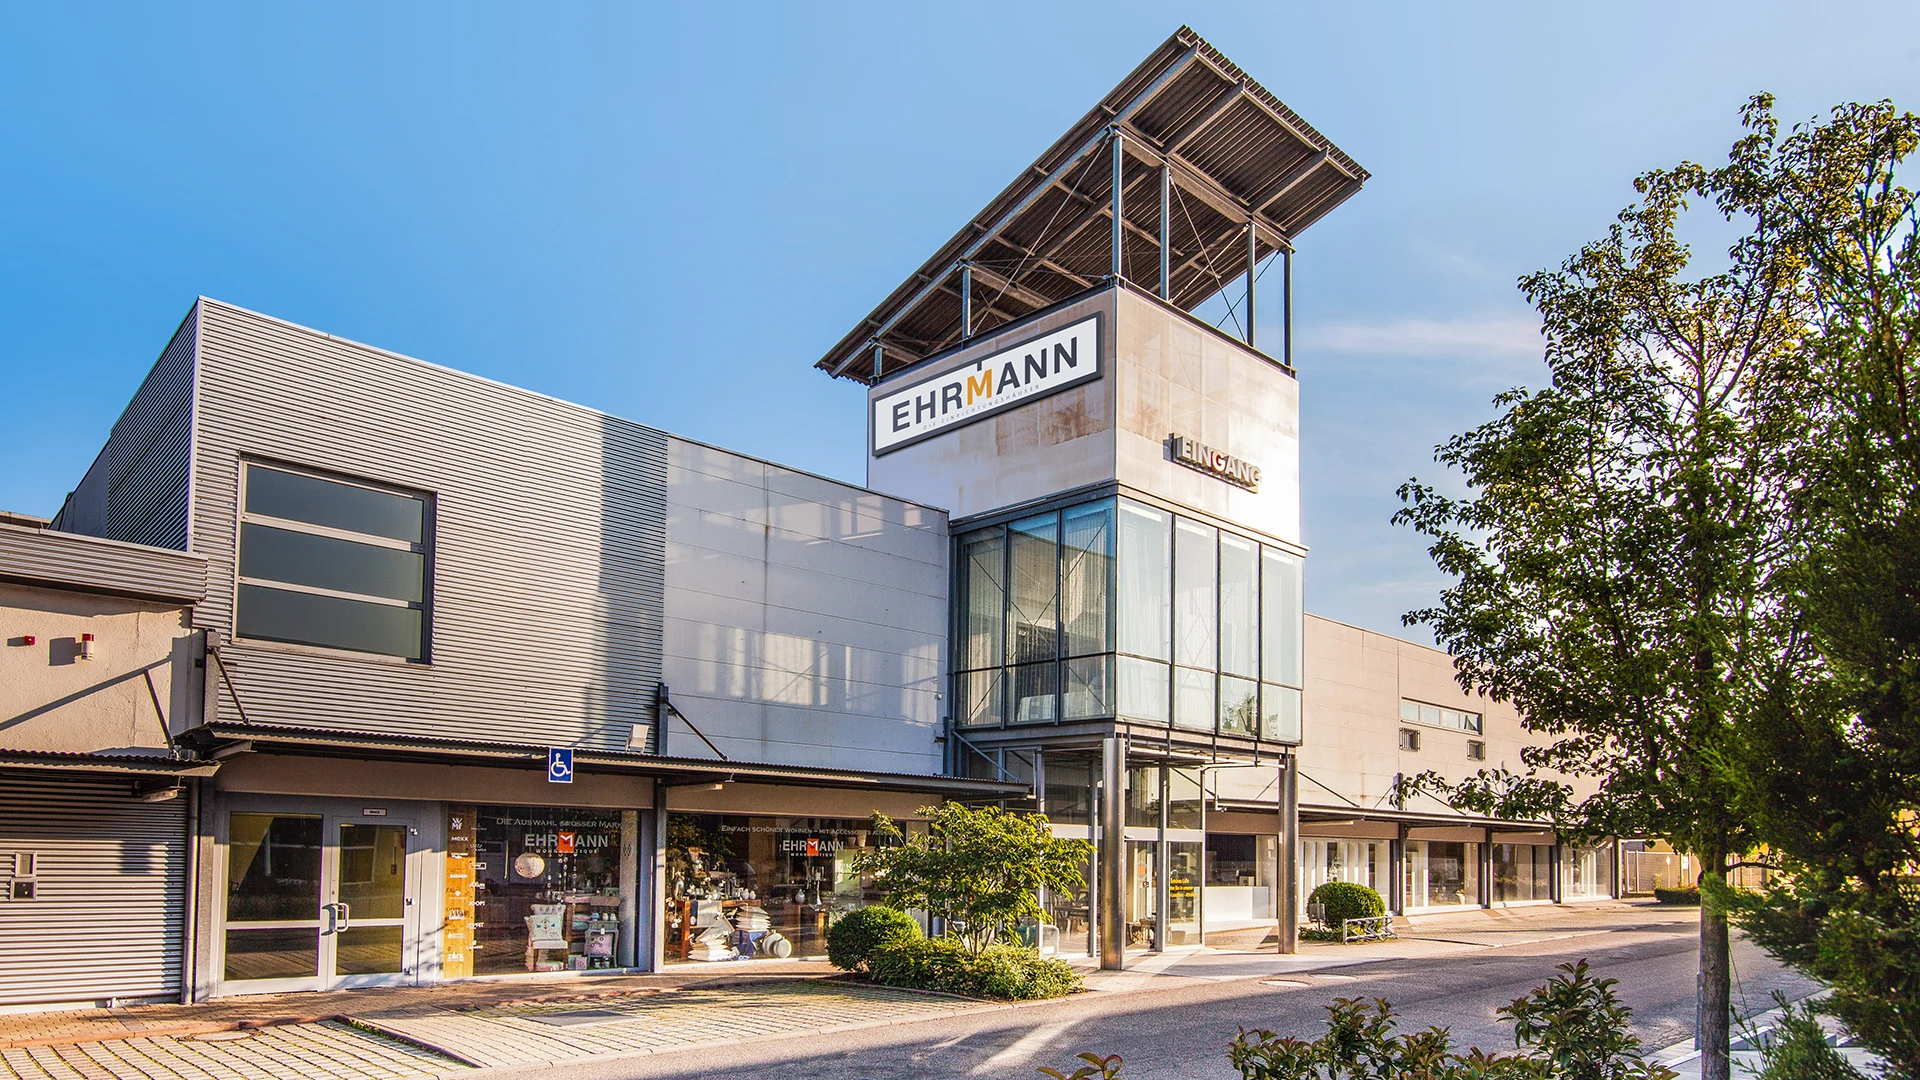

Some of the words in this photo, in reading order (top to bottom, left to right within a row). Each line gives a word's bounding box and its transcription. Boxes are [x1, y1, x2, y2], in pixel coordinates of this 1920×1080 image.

[892, 336, 1078, 433] EHRMANN
[922, 421, 937, 431] DIE
[1182, 436, 1262, 486] EINGANG
[525, 832, 608, 848] EHRMANN
[782, 838, 844, 852] EHRMANN
